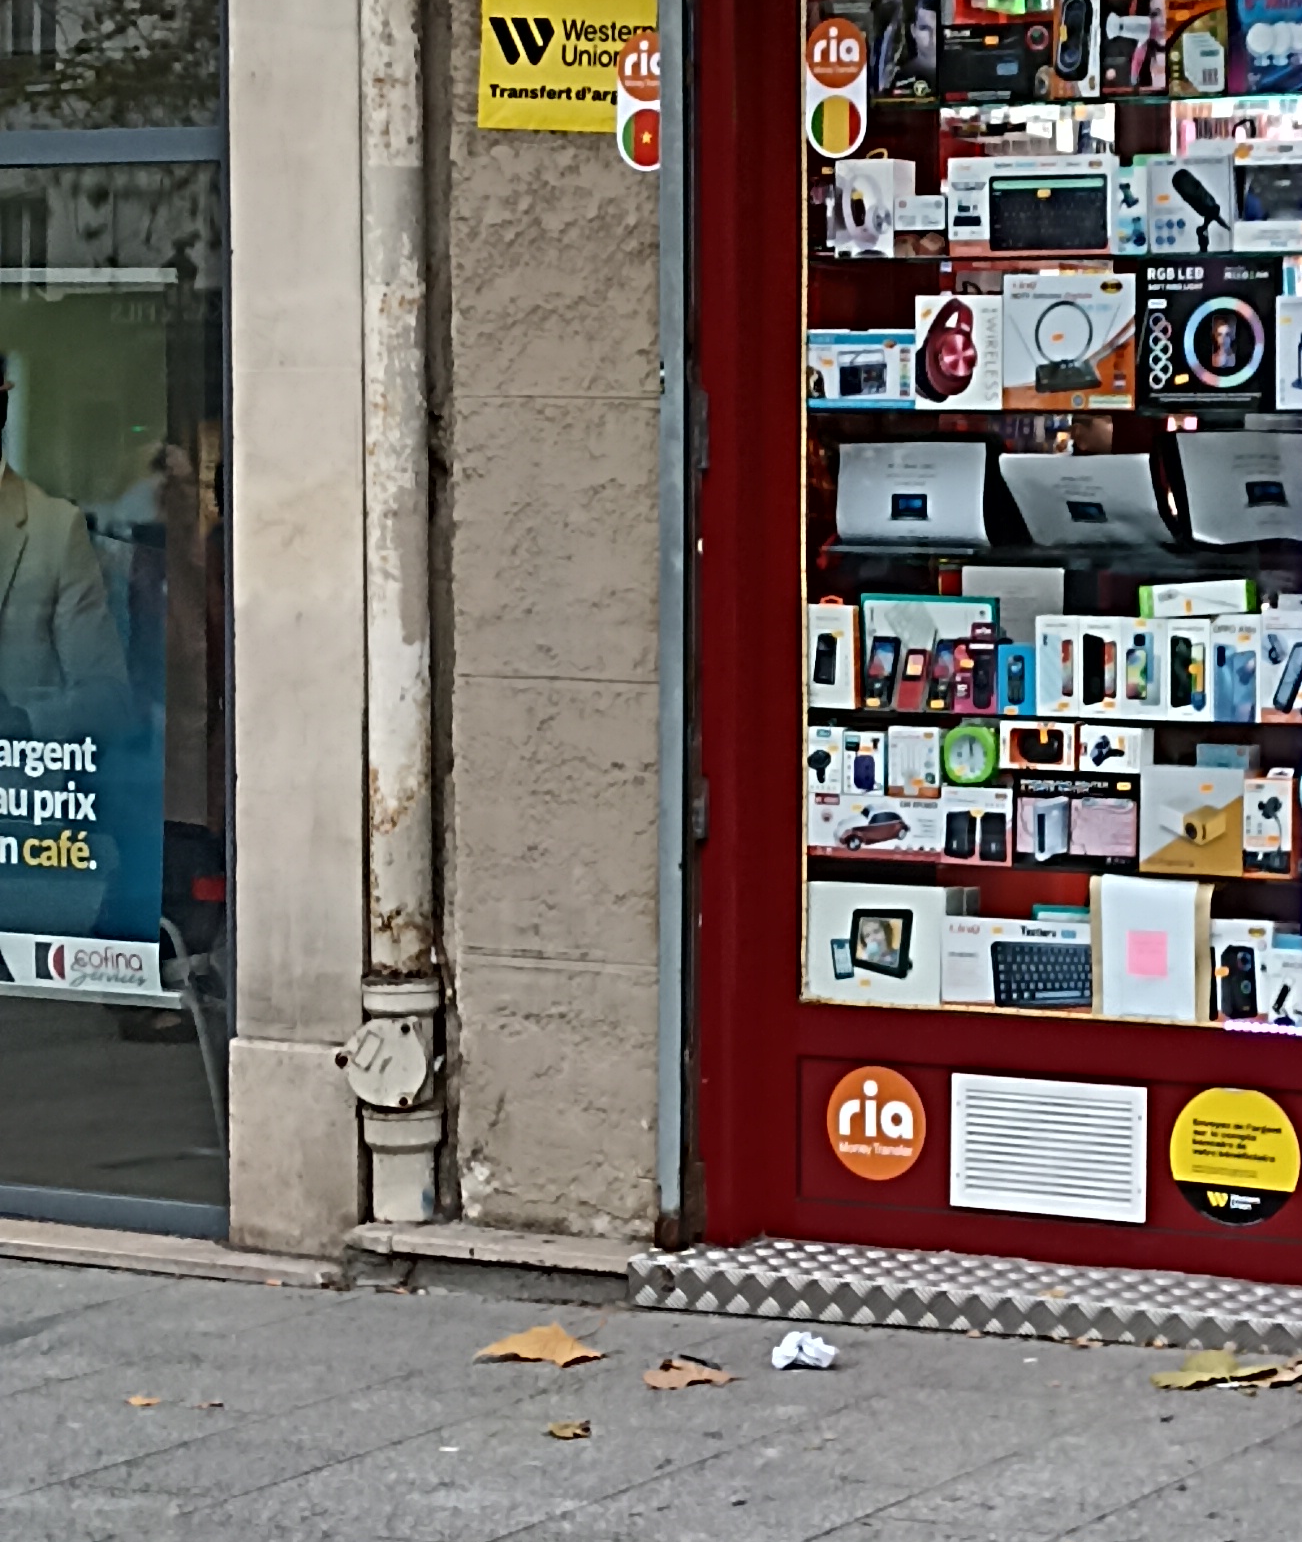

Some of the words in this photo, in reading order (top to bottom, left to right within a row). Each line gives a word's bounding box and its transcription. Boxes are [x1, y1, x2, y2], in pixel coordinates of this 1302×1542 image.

[813, 26, 860, 63] ria
[489, 84, 573, 101] Transfert
[1147, 267, 1175, 281] RGB
[1178, 267, 1205, 280] LED
[33, 780, 97, 826] prix
[23, 829, 98, 870] café.
[73, 946, 143, 972] cofina
[839, 1080, 914, 1140] ria
[838, 1141, 871, 1157] Money
[872, 1142, 913, 1157] Transfer
